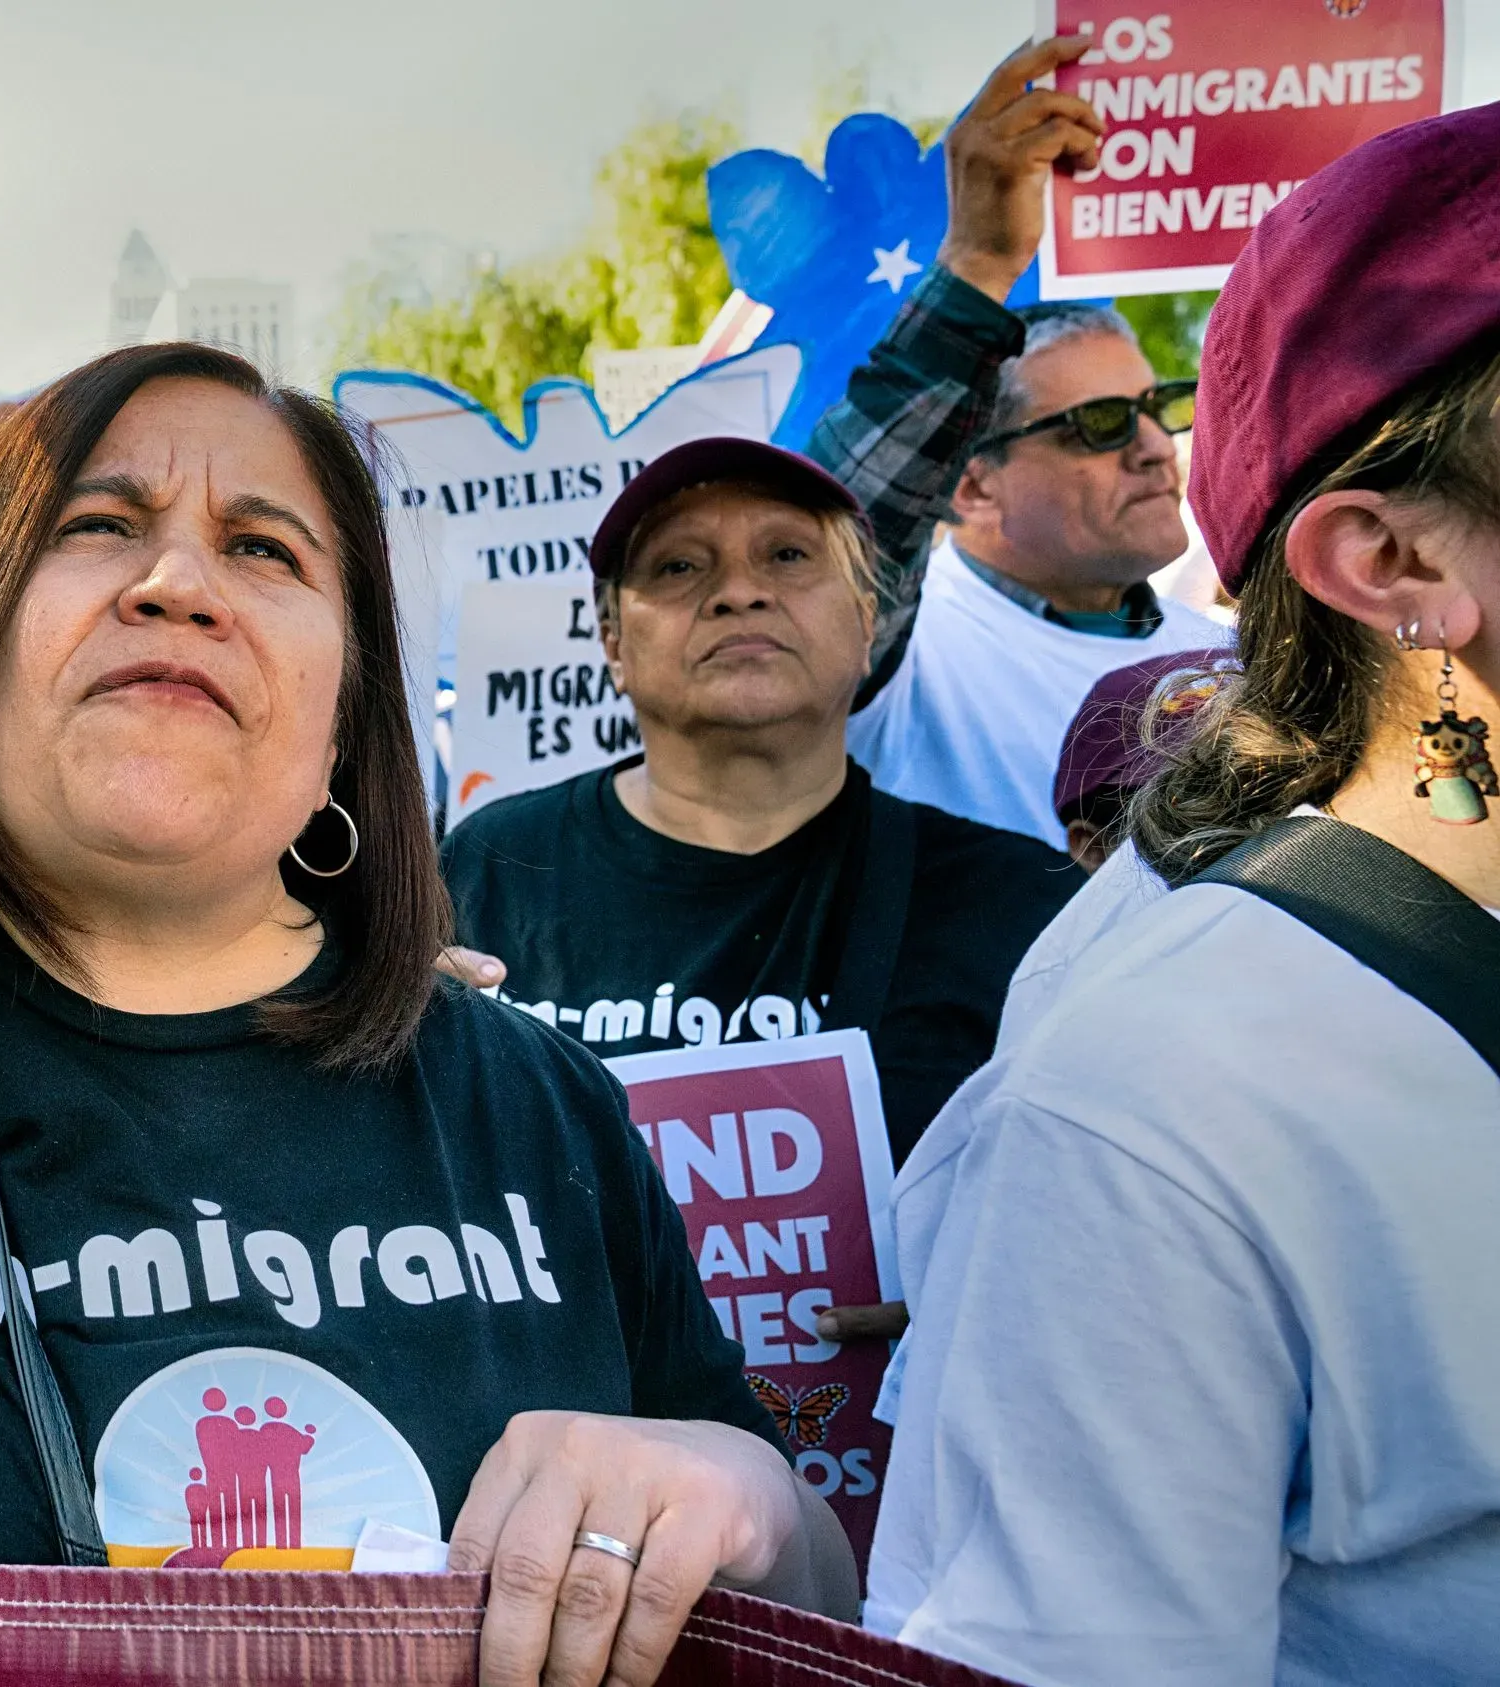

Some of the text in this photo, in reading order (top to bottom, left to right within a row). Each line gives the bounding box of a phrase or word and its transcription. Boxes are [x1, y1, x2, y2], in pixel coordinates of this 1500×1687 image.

[1077, 55, 1424, 123] INMIGRANTES
[1073, 126, 1196, 183] ON
[1071, 180, 1306, 240] BIENVEN
[643, 1107, 824, 1205] ND
